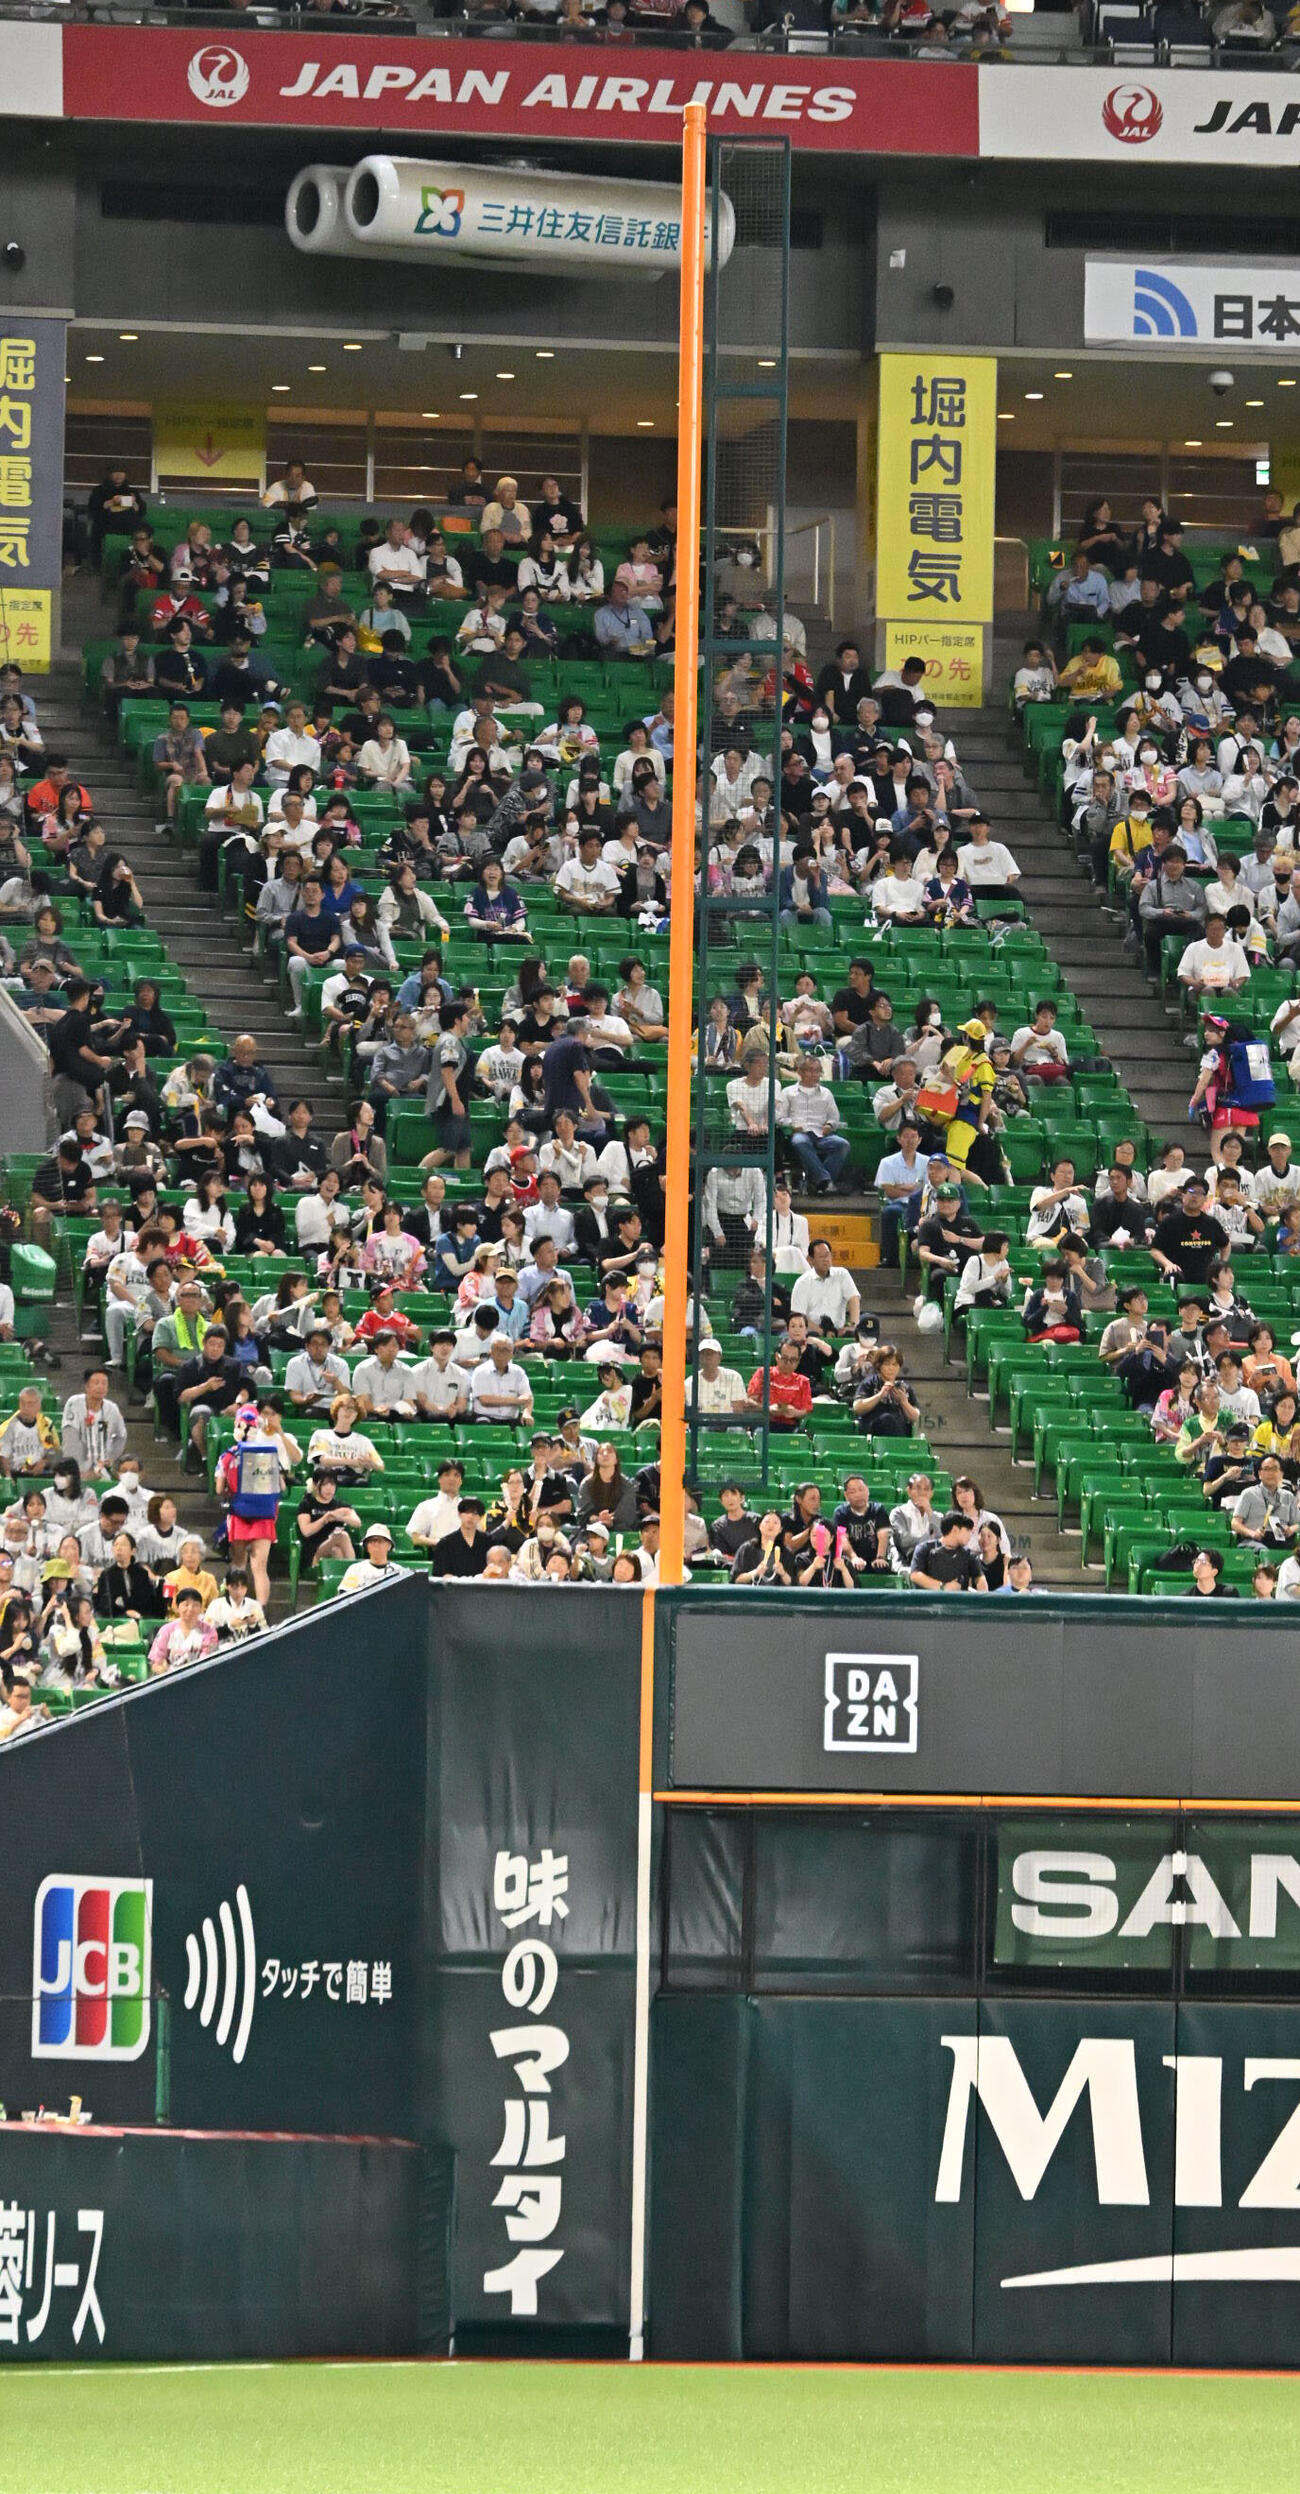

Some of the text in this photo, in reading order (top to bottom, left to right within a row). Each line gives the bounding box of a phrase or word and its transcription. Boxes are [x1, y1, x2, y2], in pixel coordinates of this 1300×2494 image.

[204, 88, 238, 100] JAL
[280, 63, 858, 121] JAPAN AIRLINES
[1118, 125, 1152, 138] JAL
[477, 203, 708, 253] 三井住友信託銀
[1213, 294, 1300, 341] 日本
[906, 375, 967, 603] 堀内電気
[894, 633, 976, 647] HIPバー指定席
[900, 656, 971, 682] の先
[847, 1669, 899, 1702] DA
[846, 1704, 897, 1737] ZN
[39, 1940, 141, 1997] JCB
[261, 1958, 393, 2005] タッチで簡単
[483, 1850, 570, 2315] 味のマルタイ
